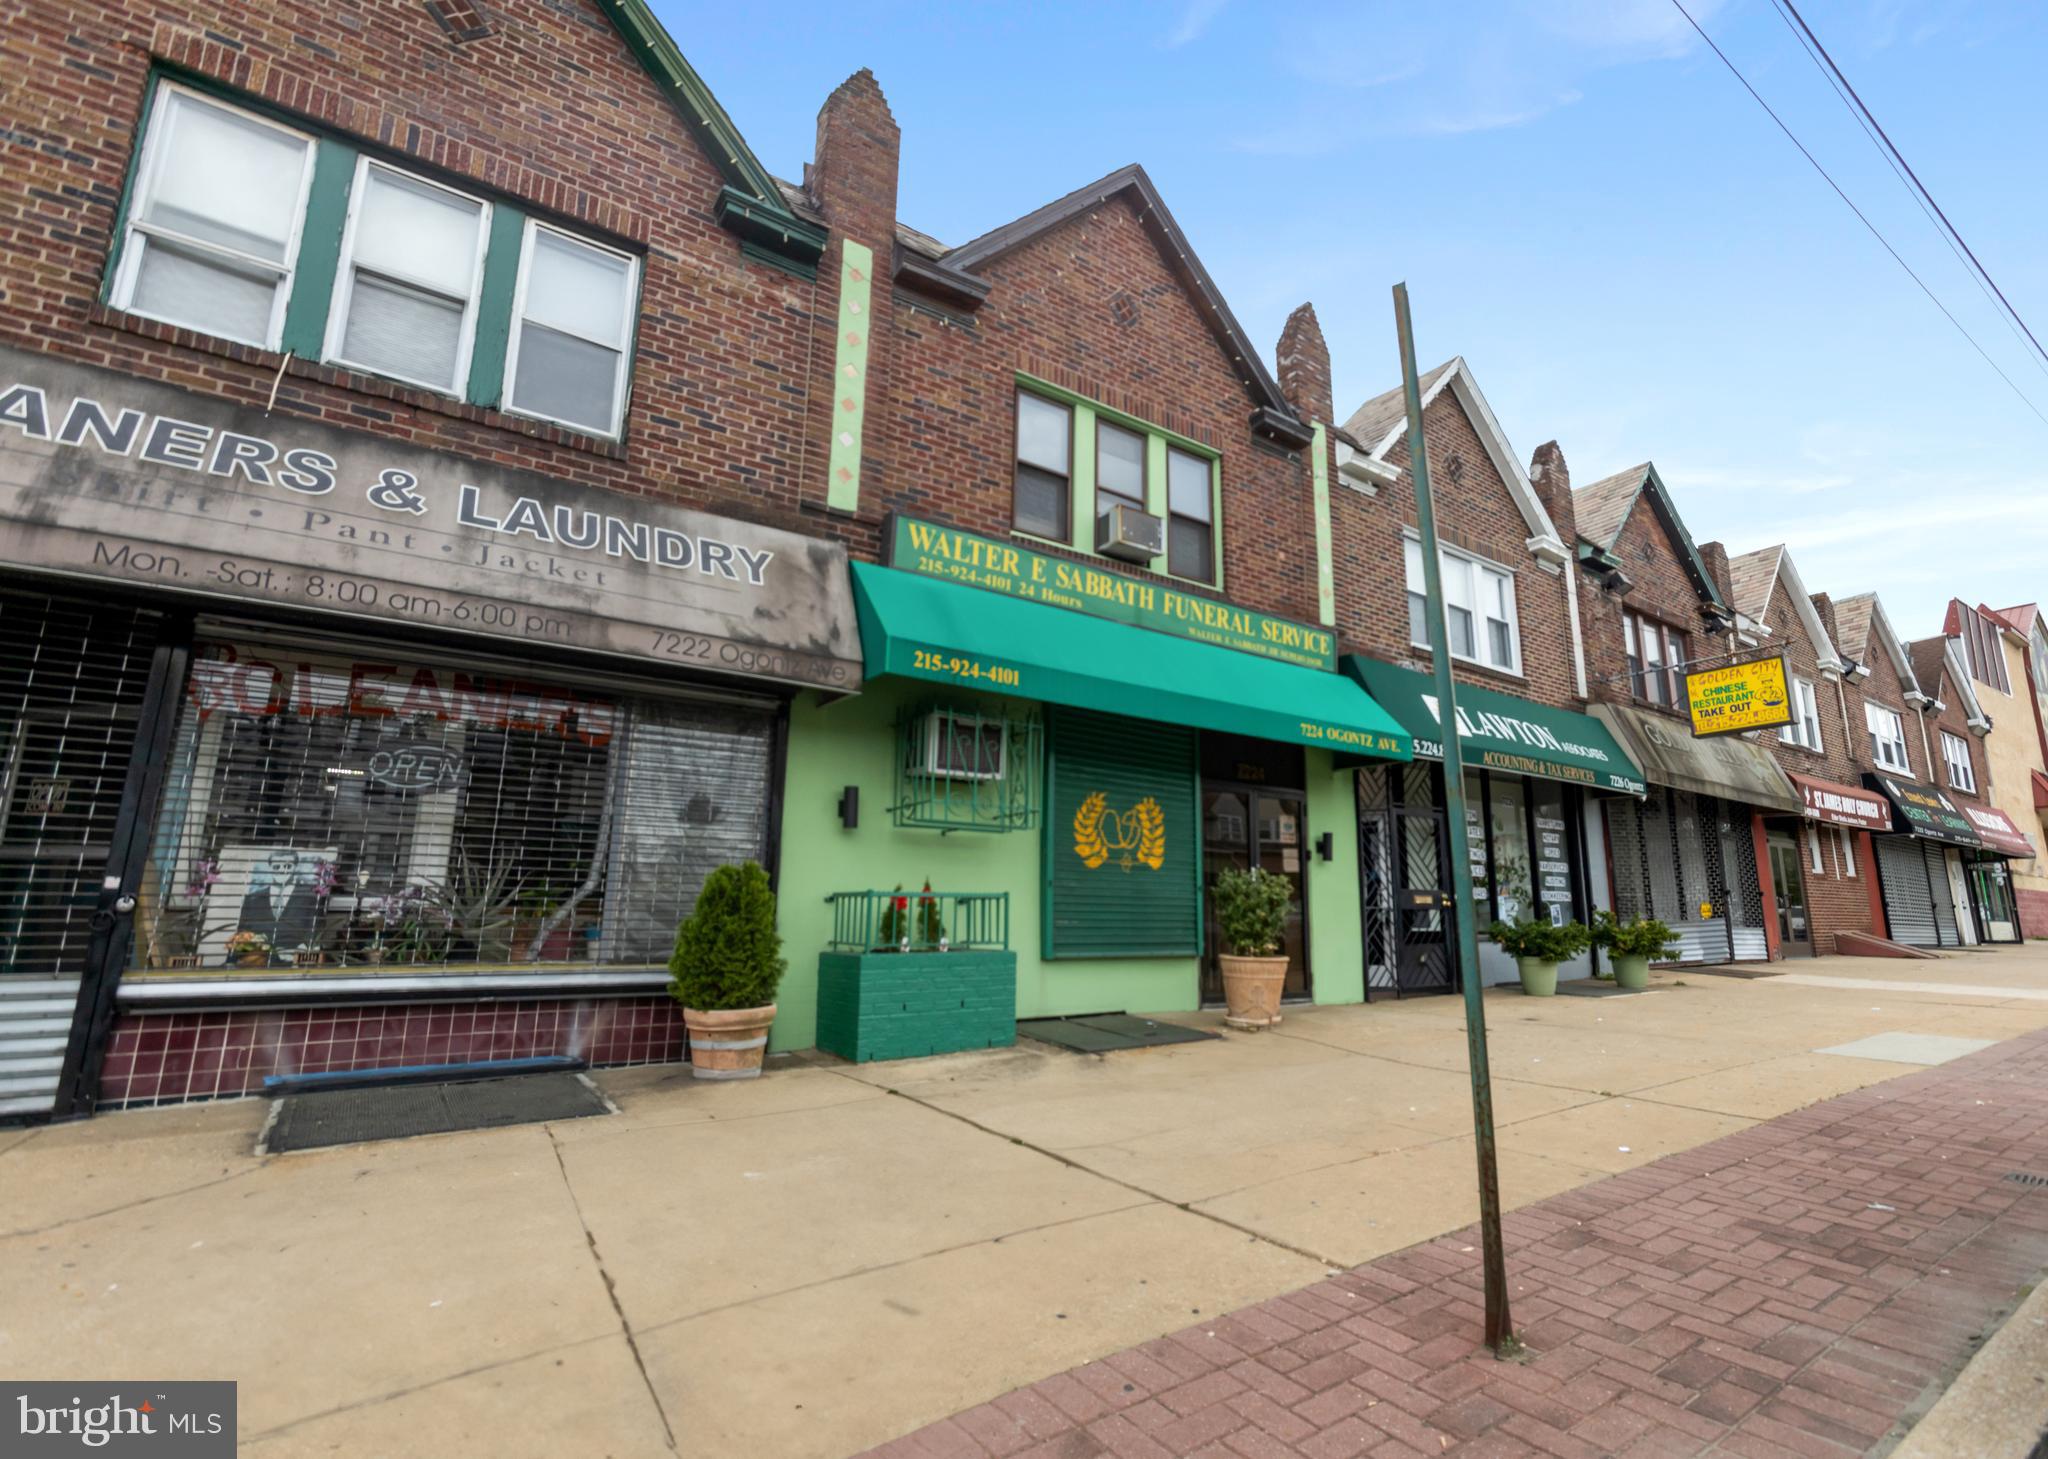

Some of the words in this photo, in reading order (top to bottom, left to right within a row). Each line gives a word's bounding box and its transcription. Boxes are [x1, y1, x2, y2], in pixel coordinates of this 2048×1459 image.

[0, 383, 338, 495] ANERS
[366, 468, 428, 515] &
[457, 484, 775, 586] LAUNDRY
[302, 510, 417, 550] Pant
[475, 545, 607, 586] Jacket
[907, 522, 1021, 576] WALTER
[1031, 556, 1047, 584] E
[1055, 563, 1155, 611] SABBATH
[1163, 592, 1255, 637] FUNERAL
[1261, 619, 1330, 656] SERVICE
[918, 556, 1012, 592] 215-924-4101
[1018, 581, 1035, 597] 24
[1041, 587, 1083, 609] Hours
[93, 541, 188, 578] Mon.
[652, 630, 712, 660] 7222
[913, 650, 1019, 687] 215-924-4101
[1699, 668, 1744, 685] GOLDEN
[1751, 660, 1779, 675] CITY
[1692, 690, 1755, 710] RESTAURANT
[1702, 681, 1748, 698] CHINESE
[1698, 705, 1725, 719] TAKE
[1729, 701, 1752, 713] OUT
[1300, 723, 1323, 738] 7224
[1326, 727, 1374, 748] OGONTZ
[1377, 738, 1401, 753] AVE.
[1455, 705, 1563, 752] LAWTON
[369, 751, 464, 782] OPEN
[1483, 751, 1539, 774] ACCOUNTING
[1538, 762, 1546, 775] &
[1547, 762, 1563, 778] TAX
[1563, 765, 1596, 783] SERVICES
